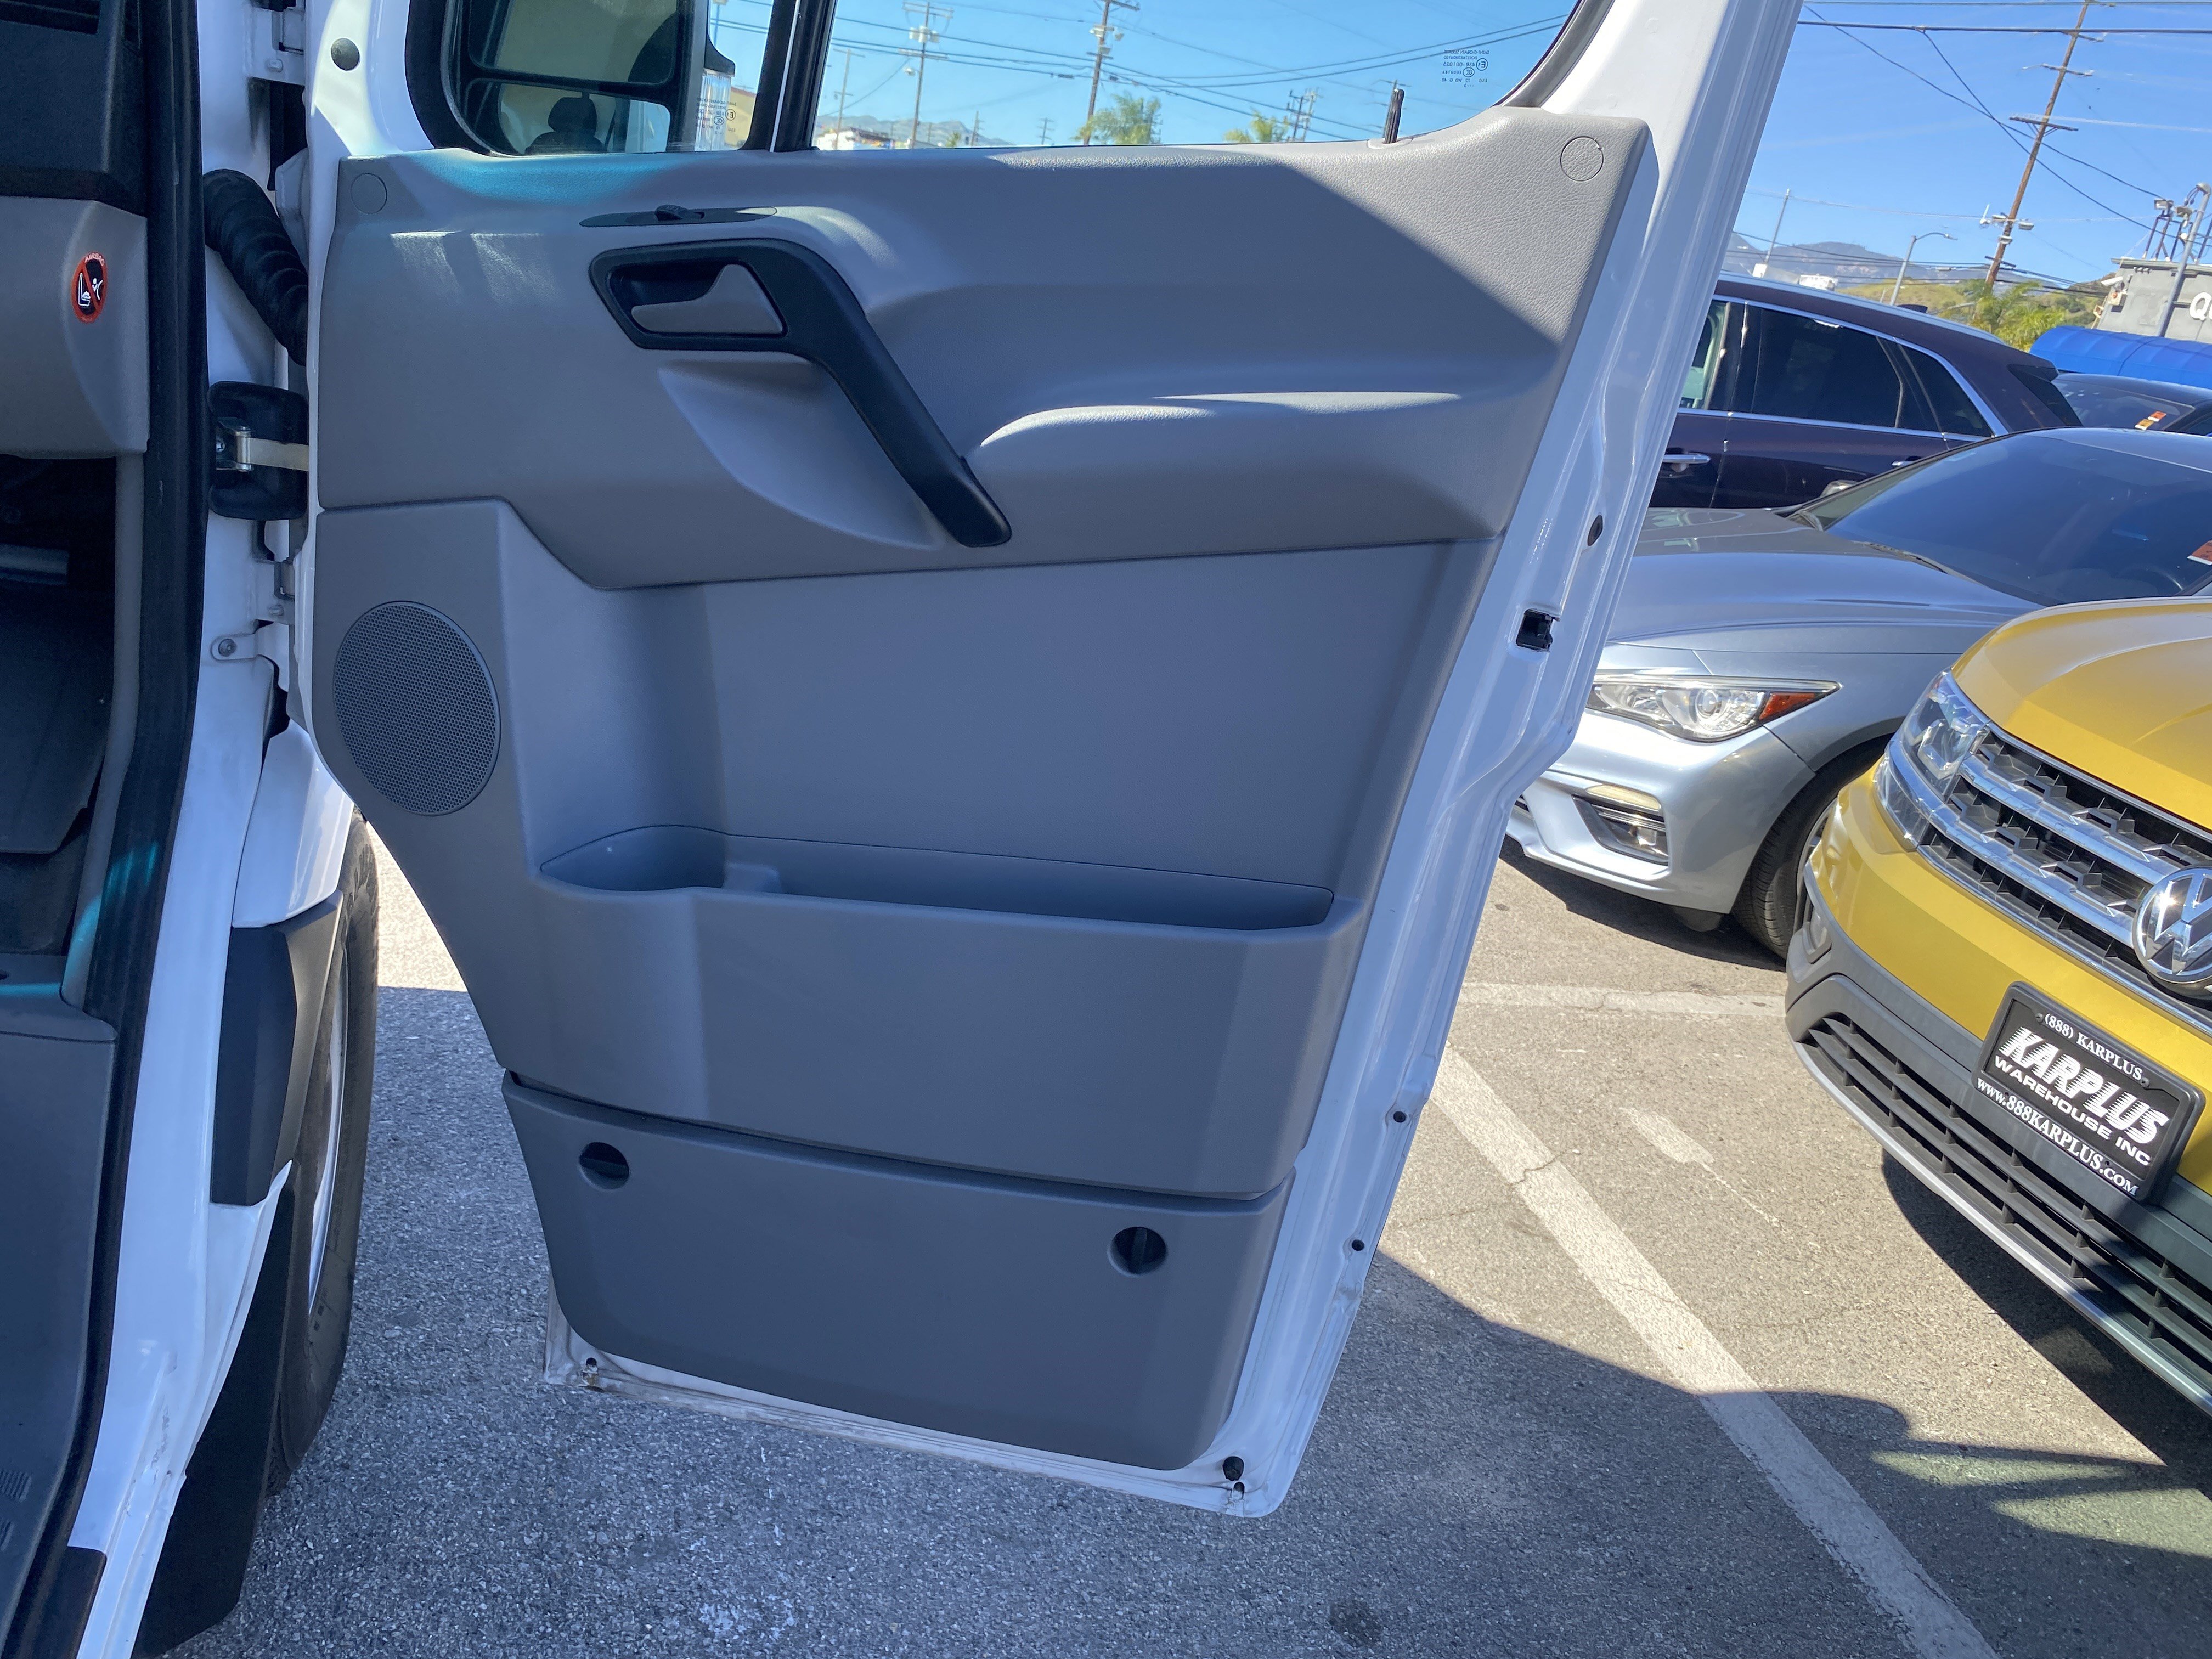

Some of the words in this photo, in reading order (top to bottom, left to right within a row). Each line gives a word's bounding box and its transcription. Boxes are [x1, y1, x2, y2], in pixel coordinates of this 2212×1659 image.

[84, 252, 105, 266] AIRBAG
[1999, 1026, 2170, 1145] KARPLUS
[2045, 1013, 2074, 1039] (888)
[2076, 1032, 2143, 1080] KARPLUS
[1995, 1056, 2112, 1140] WAREHOUSE
[2115, 1136, 2151, 1166] INC
